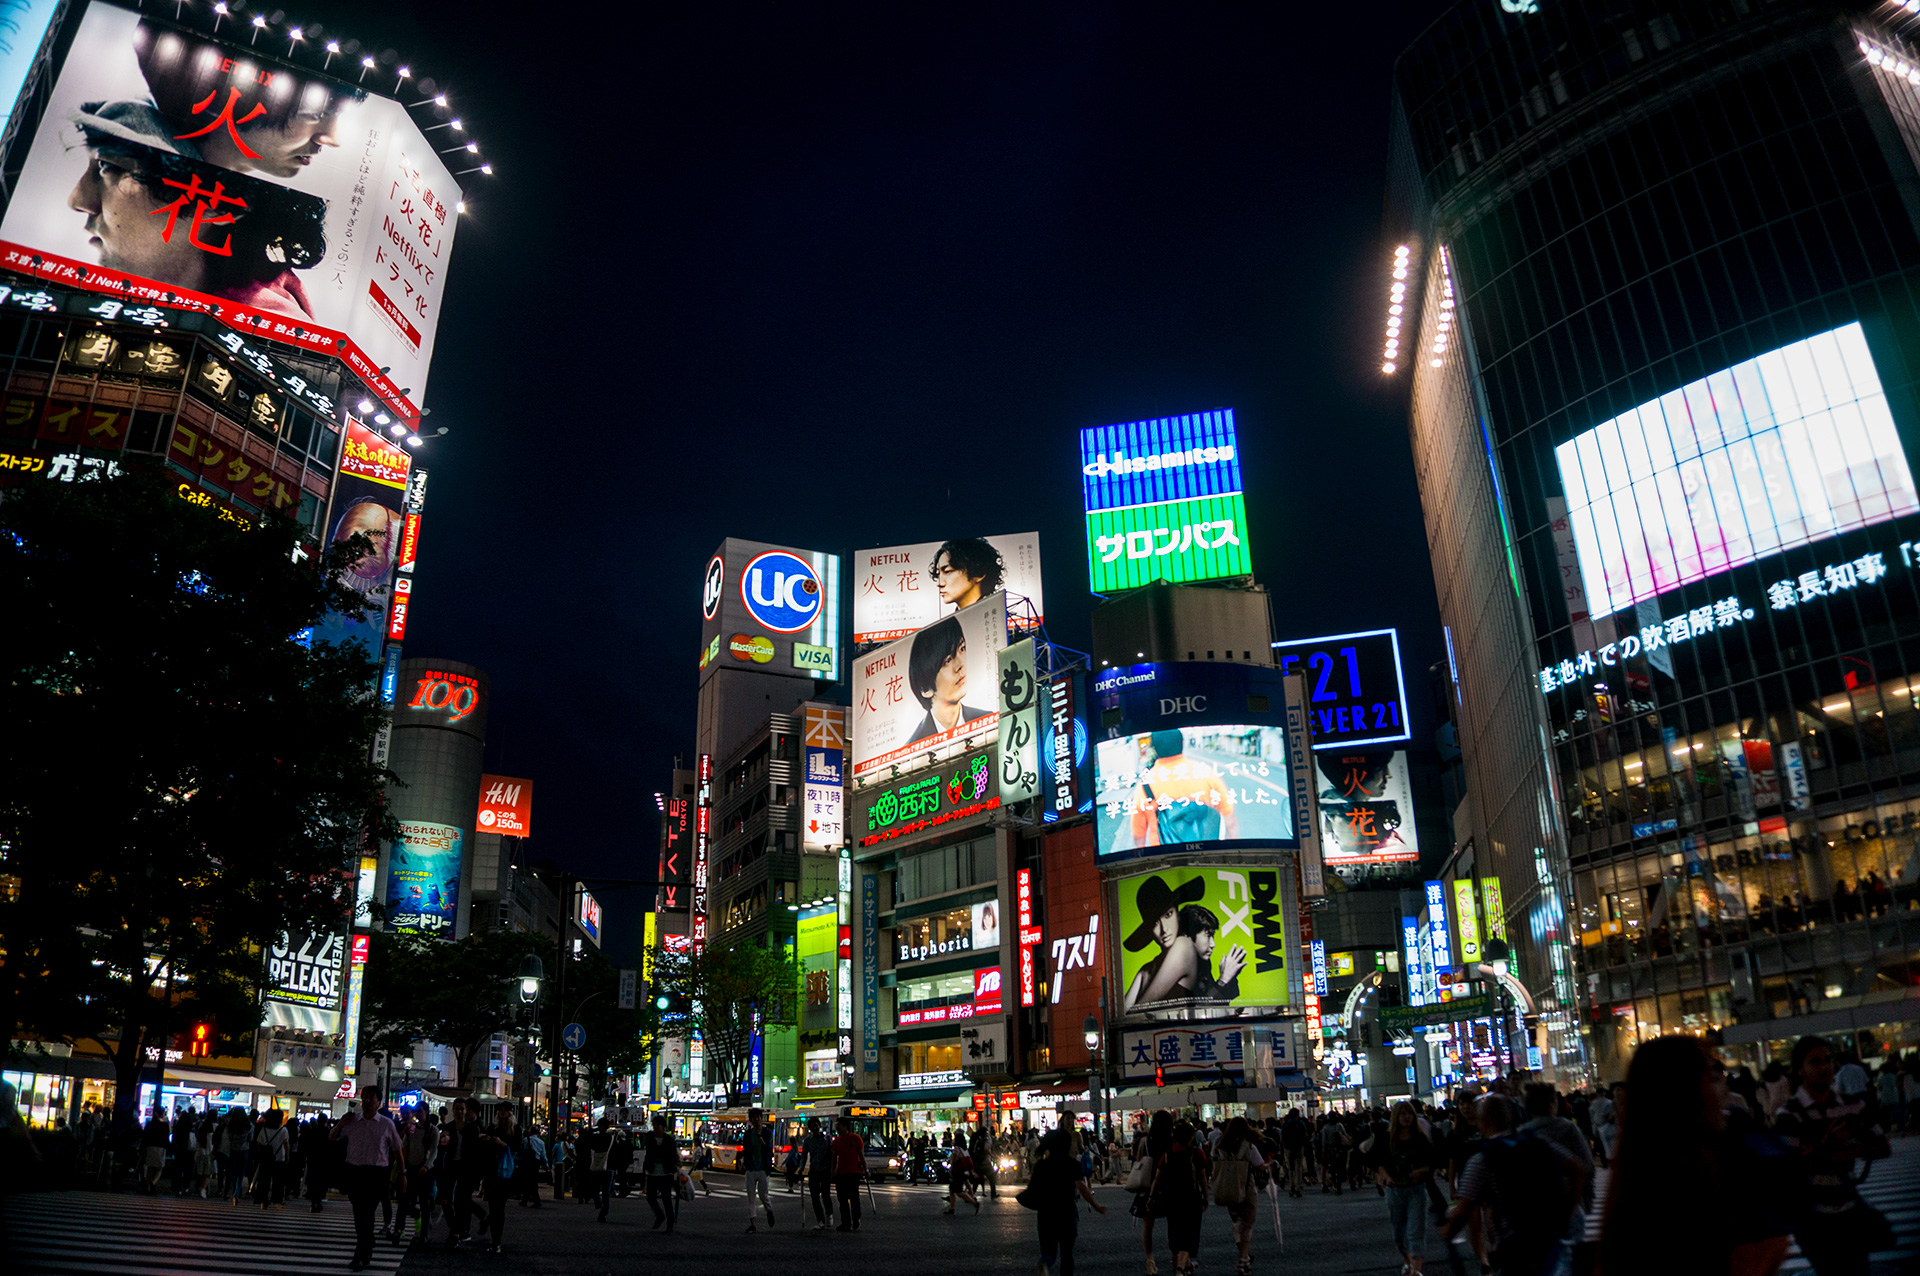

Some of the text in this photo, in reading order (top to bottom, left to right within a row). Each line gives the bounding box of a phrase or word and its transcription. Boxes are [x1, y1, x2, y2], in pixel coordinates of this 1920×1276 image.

[389, 180, 441, 259] 「火花」
[382, 214, 434, 286] Netflixで
[375, 245, 428, 320] ドラマ化
[172, 422, 294, 510] コンタクト
[341, 455, 407, 480] メジャーデビュー
[1082, 443, 1235, 478] Hisamitsu
[1095, 518, 1240, 564] サロンパス
[870, 552, 910, 567] NETFLIX
[863, 569, 920, 597] 火花
[1766, 551, 1888, 611] 翁長知事
[392, 603, 407, 633] ガスト
[729, 641, 775, 656] MasterCard
[799, 649, 831, 665] VISA
[425, 670, 479, 688] SHIBUYA
[864, 652, 897, 680] NETFLIX
[384, 673, 395, 702] イーオン
[1095, 670, 1156, 693] DHC Channel
[407, 677, 479, 722] 109
[858, 674, 904, 721] 火花
[1159, 695, 1208, 717] DHC
[1000, 660, 1037, 793] もんじゃ
[1371, 700, 1400, 729] 21
[1051, 681, 1073, 811] 三千里薬品
[808, 774, 840, 783] ブックファースト
[1287, 699, 1312, 839] Taisei neon
[484, 781, 522, 808] H&M
[807, 788, 841, 803] 夜11時
[813, 803, 835, 815] まで
[899, 785, 941, 821] 西村
[1105, 788, 1279, 819] 学生に会ってきました。
[1343, 767, 1378, 838] 火花
[496, 810, 517, 820] この先
[496, 819, 523, 831] 150m
[821, 821, 841, 834] 地下
[665, 799, 687, 906] KATE TOKYO
[1185, 843, 1205, 851] DHC
[1217, 870, 1252, 939] FX
[420, 913, 452, 930] ドリー
[1249, 871, 1284, 974] DMM
[1427, 884, 1450, 966] 洋服の青山
[331, 935, 345, 969] WED
[864, 899, 876, 999] サマーフルーツギフト
[900, 934, 970, 961] Euphoria
[1050, 913, 1100, 1005] クスリ
[269, 957, 341, 997] RELEASE
[1404, 926, 1425, 1007] 洋服の青山
[976, 970, 1001, 997] JTB
[668, 1085, 714, 1103] グルメタウン
